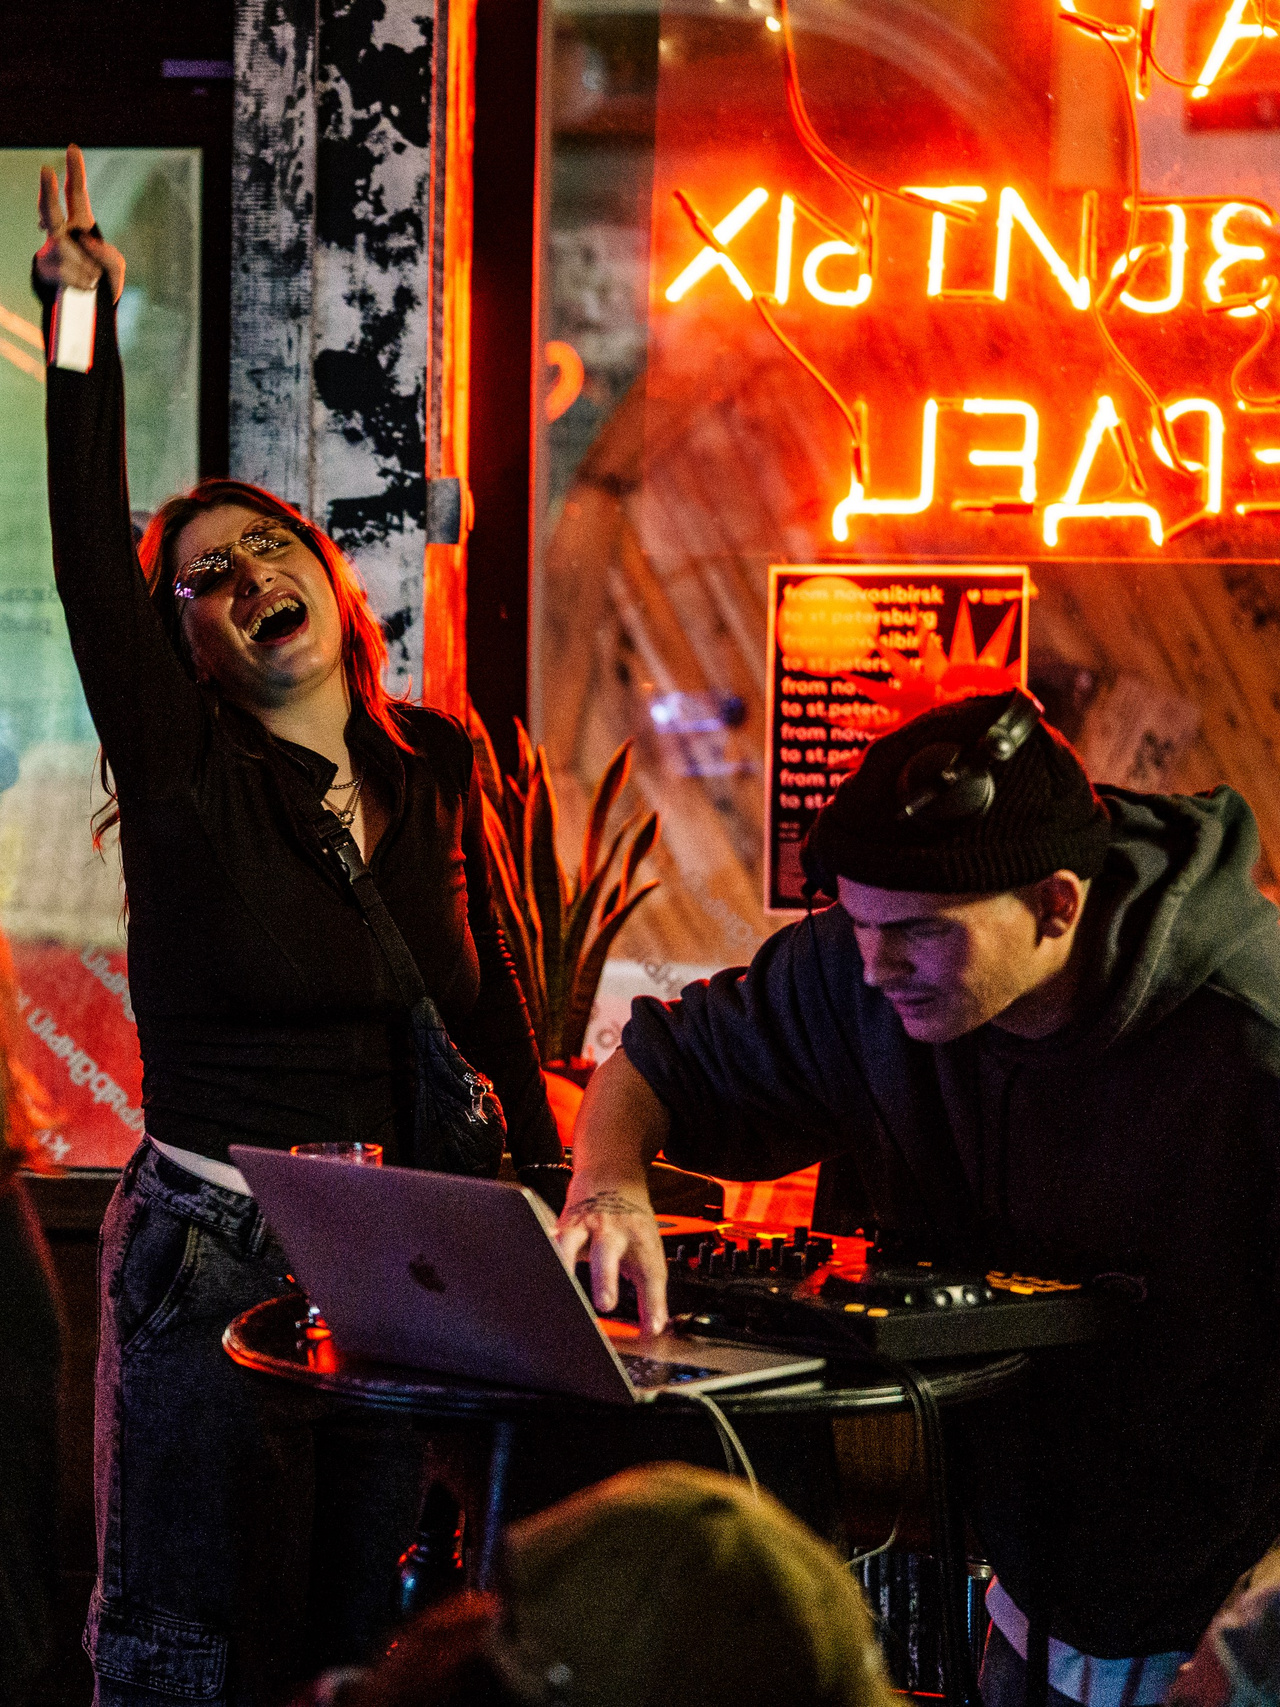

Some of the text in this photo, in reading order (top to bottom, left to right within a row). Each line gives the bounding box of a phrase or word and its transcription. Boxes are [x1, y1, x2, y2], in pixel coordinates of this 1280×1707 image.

[783, 584, 945, 604] from novosibirsk
[781, 677, 828, 695] from
[781, 700, 802, 717] to
[781, 723, 827, 741] from
[780, 747, 801, 763] to
[780, 769, 826, 787] from
[779, 793, 800, 809] to
